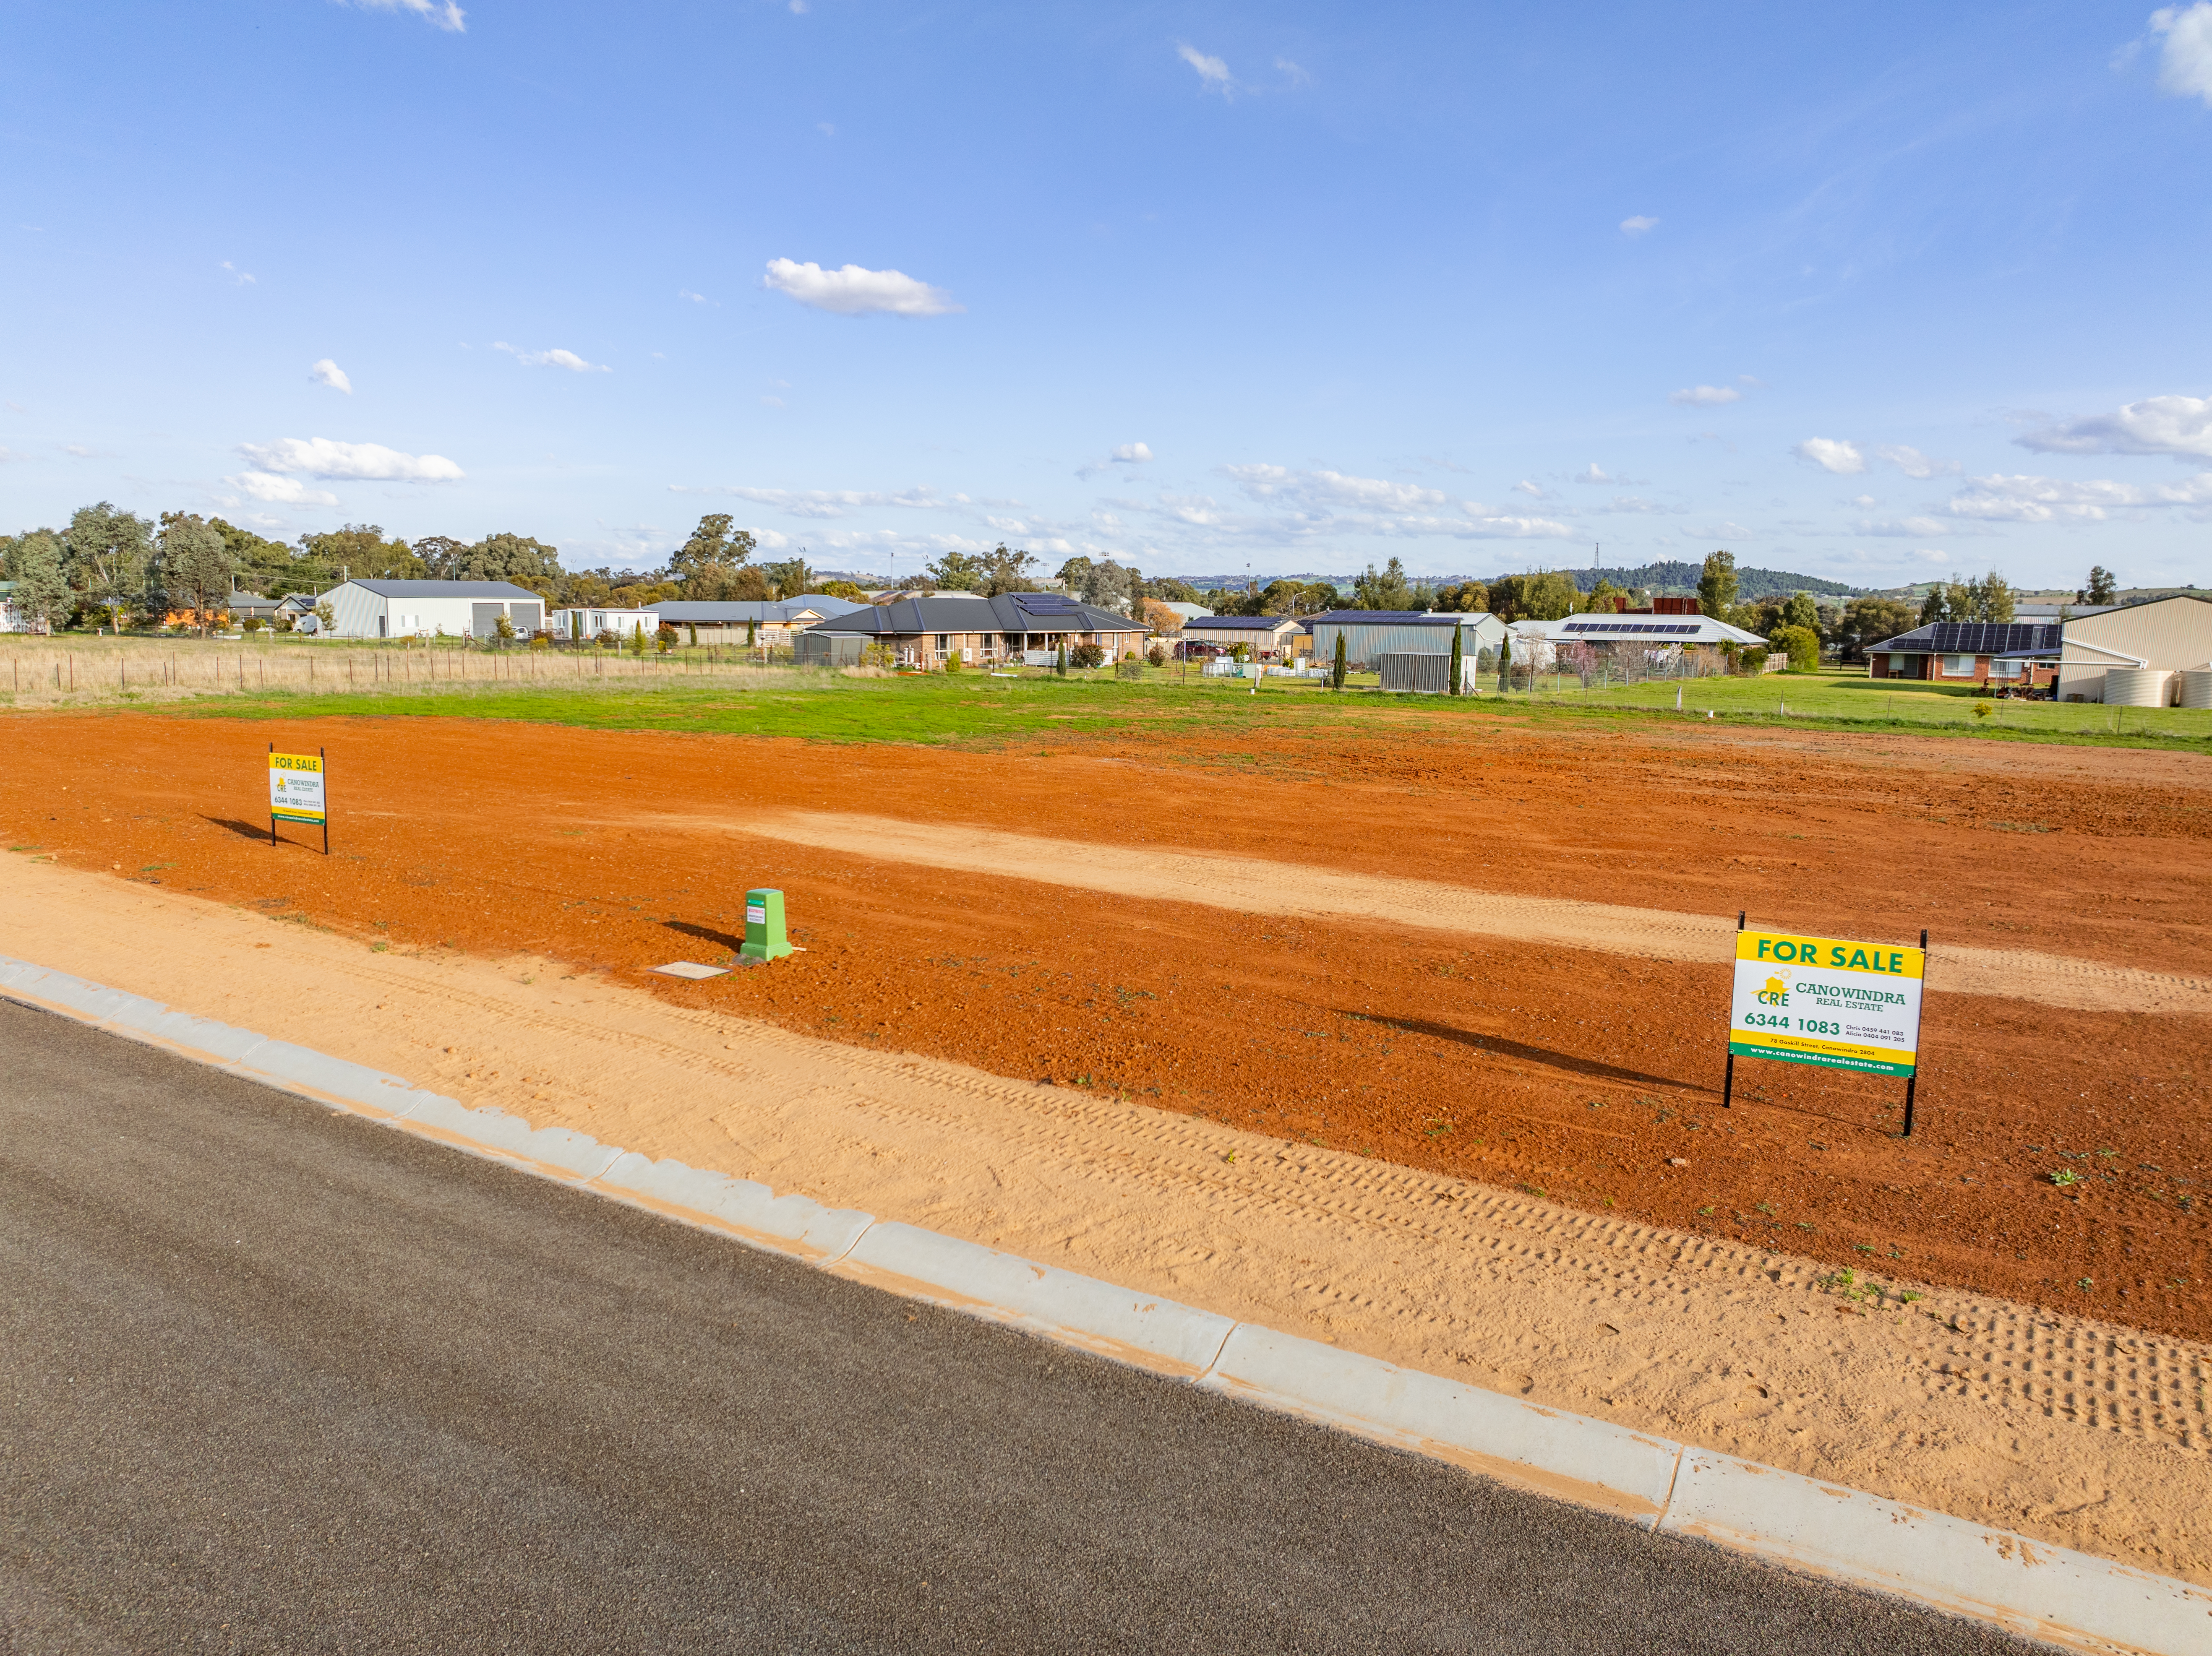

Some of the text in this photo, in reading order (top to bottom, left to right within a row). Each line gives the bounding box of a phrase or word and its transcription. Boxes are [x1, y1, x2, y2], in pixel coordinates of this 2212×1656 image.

[275, 757, 317, 771] FOR SALE
[287, 779, 319, 788] CANOWINDRA
[1757, 939, 1903, 974] FOR SALE
[1758, 990, 1789, 1007] CRE
[1796, 982, 1906, 1005] CANOWINDRA
[1816, 997, 1883, 1012] REAL ESTATE
[1745, 1013, 1840, 1035] 6344 1083
[1822, 1045, 1857, 1054] Canowindra
[1750, 1047, 1894, 1071] www.canowindrarealestate.com
